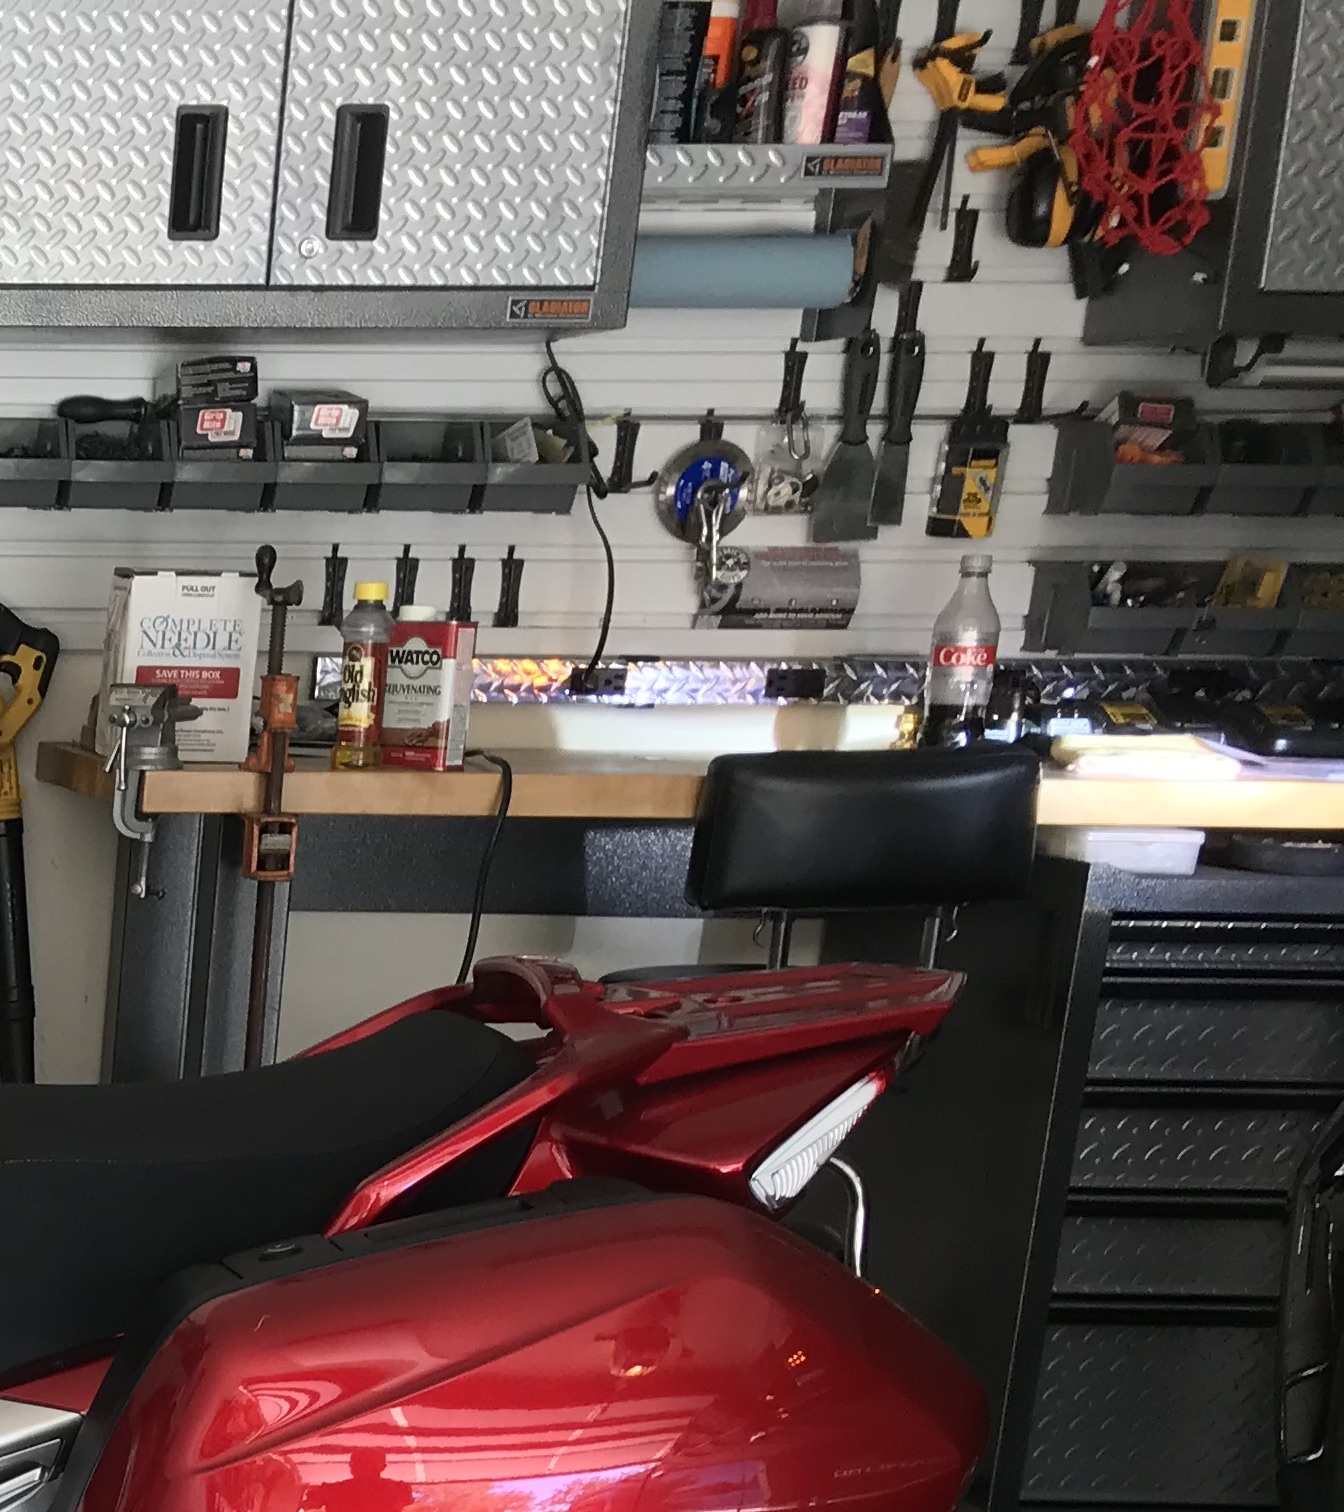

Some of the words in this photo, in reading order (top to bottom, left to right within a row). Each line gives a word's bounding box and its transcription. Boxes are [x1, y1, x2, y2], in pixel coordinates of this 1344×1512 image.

[528, 301, 589, 314] GLADIATOR
[181, 585, 200, 593] PULL
[201, 585, 216, 593] OUT
[140, 615, 243, 632] COMPLETE
[139, 630, 242, 651] NEEDLE
[171, 642, 187, 658] &
[389, 649, 440, 666] WATCO
[939, 647, 988, 666] Coke
[155, 669, 179, 679] SAVE
[180, 670, 200, 679] THIS
[201, 671, 221, 680] BOX
[343, 663, 364, 684] Old
[339, 681, 376, 709] nglish
